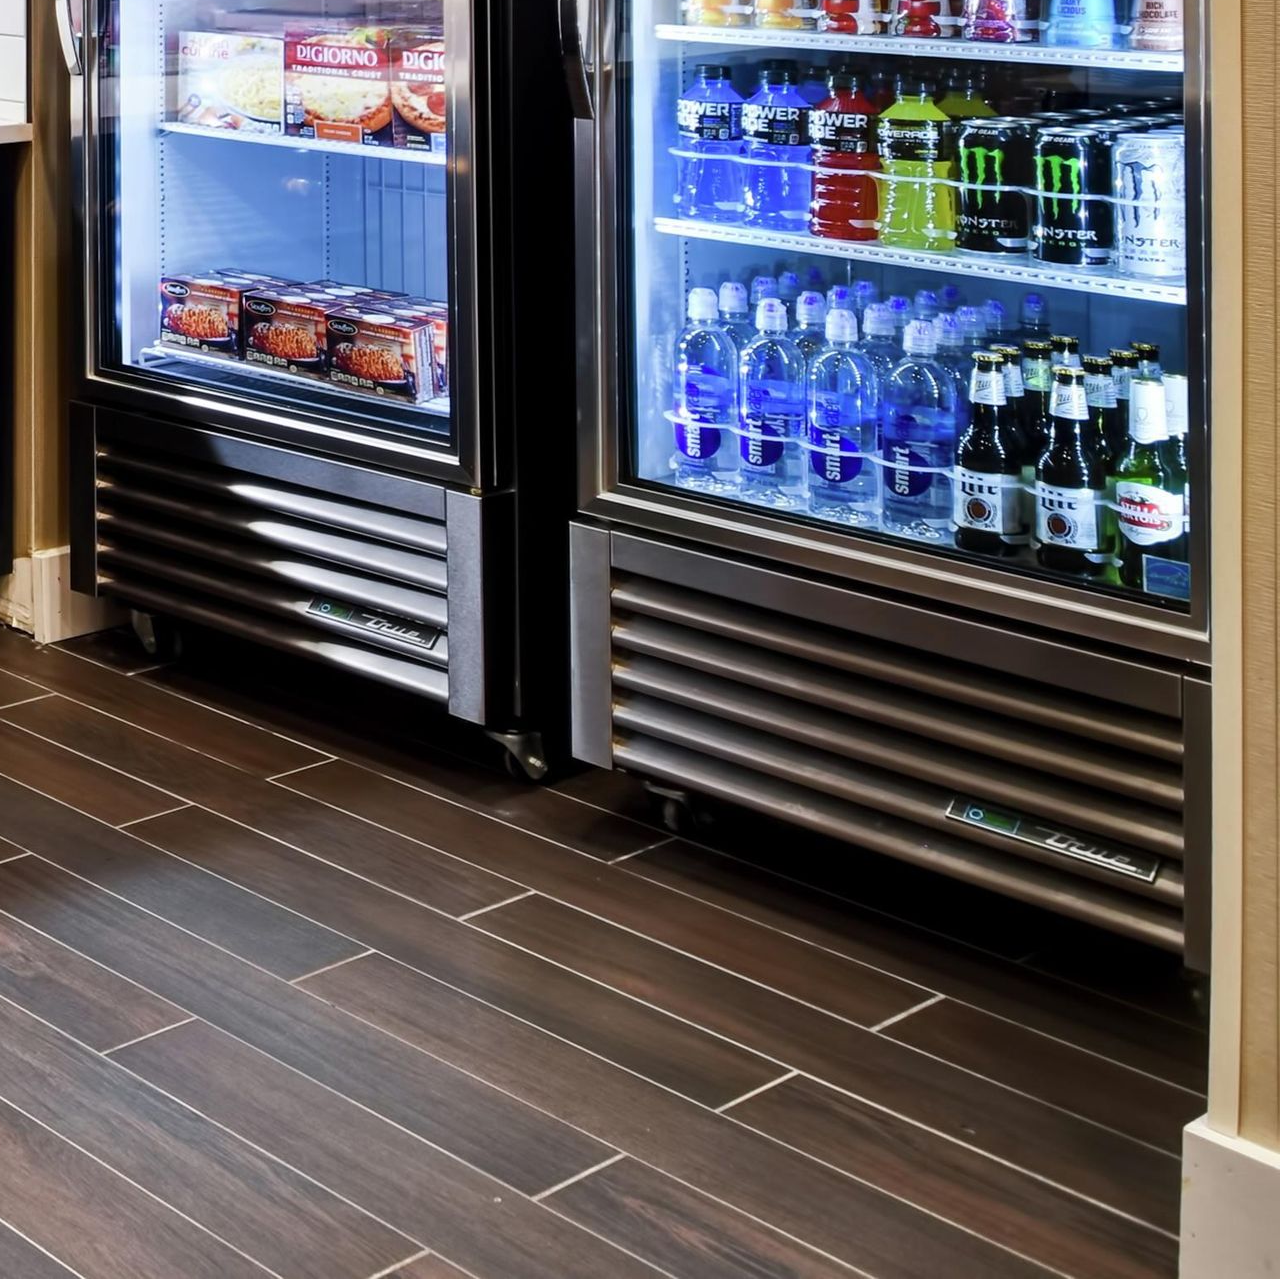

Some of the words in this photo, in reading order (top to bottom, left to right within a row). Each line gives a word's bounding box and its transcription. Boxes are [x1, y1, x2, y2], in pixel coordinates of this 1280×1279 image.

[1146, 1, 1164, 9] RICH
[296, 45, 378, 67] DIGIORNO
[292, 64, 349, 76] TRADITIONAL
[352, 69, 382, 79] CRUST
[677, 99, 729, 116] POWER
[742, 103, 800, 121] POWER
[809, 110, 868, 128] POWER
[1124, 235, 1180, 248] NSTER
[687, 412, 701, 458] smart
[746, 418, 763, 465] smart
[823, 429, 841, 481] smart
[893, 446, 910, 495] smart
